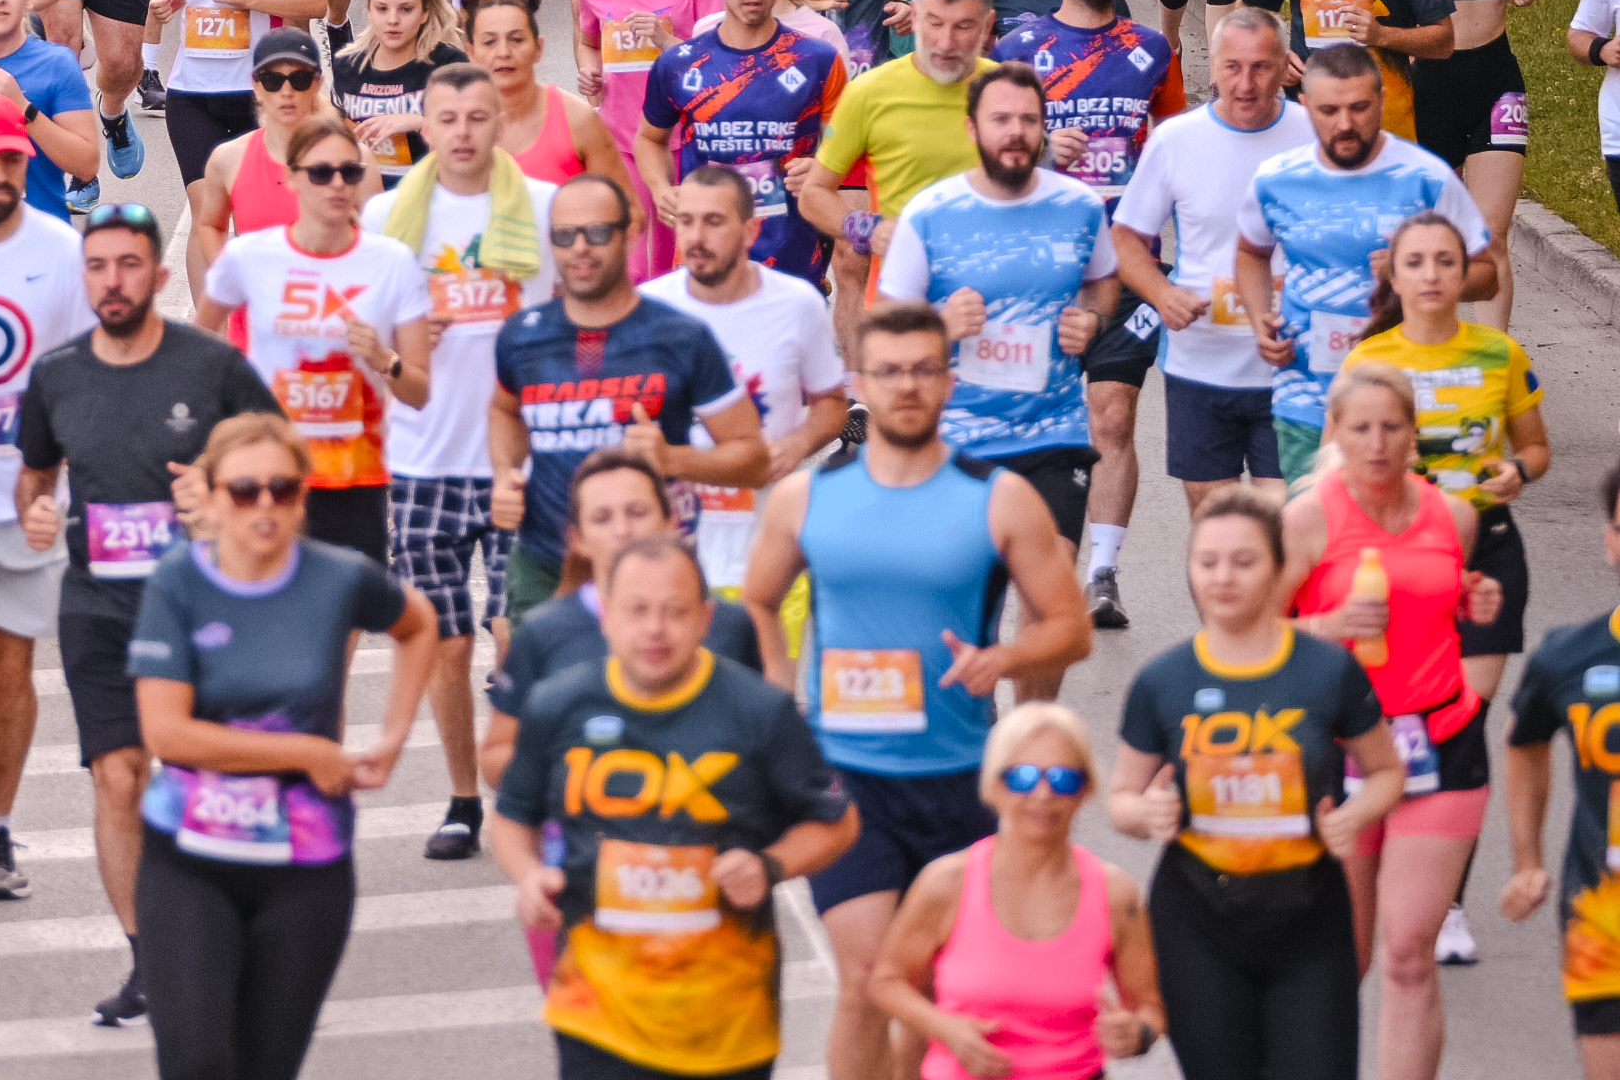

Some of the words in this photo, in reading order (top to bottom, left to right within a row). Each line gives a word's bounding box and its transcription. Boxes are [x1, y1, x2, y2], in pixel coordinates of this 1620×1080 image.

[195, 17, 236, 38] 1271
[360, 83, 404, 97] ARIZONA
[1045, 100, 1075, 116] TIM
[1077, 98, 1109, 111] BEZ
[1111, 96, 1149, 114] FRKE
[693, 121, 718, 137] TIM
[720, 121, 754, 136] BEZ
[756, 121, 798, 137] FRKE
[1045, 117, 1066, 129] ZA
[711, 136, 753, 152] FEŠTE
[761, 139, 794, 152] TRKE
[281, 282, 369, 323] 5K
[446, 278, 507, 308] 5172
[1133, 314, 1154, 330] LK
[975, 338, 1035, 364] 8011
[286, 381, 350, 409] 5167
[101, 520, 172, 550] 2314
[1179, 708, 1306, 761] 10K
[563, 747, 741, 822] 10K
[192, 786, 279, 828] 2064
